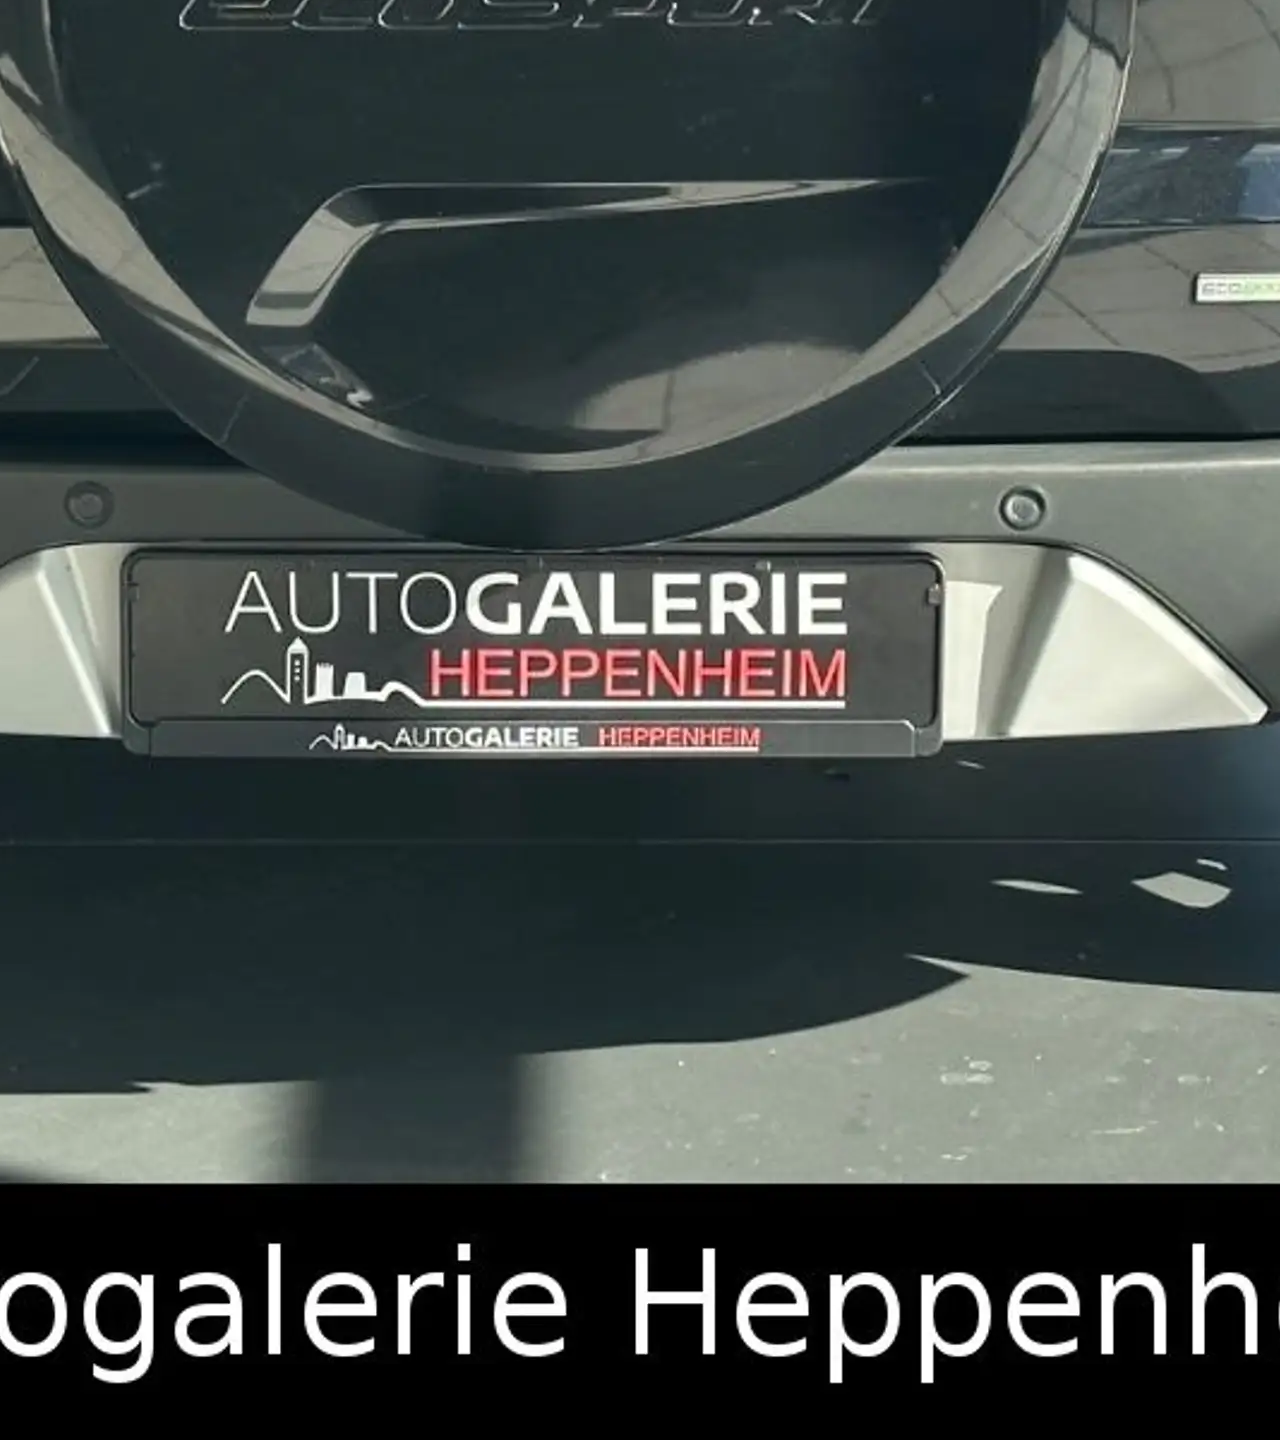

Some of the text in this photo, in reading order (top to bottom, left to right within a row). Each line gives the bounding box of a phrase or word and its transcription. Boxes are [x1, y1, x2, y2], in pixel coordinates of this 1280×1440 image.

[224, 571, 848, 636] AUTOGALERIE
[430, 648, 846, 698] HEPPENHEIM
[395, 727, 761, 748] AUTOGALERIE HEPPENHEIM
